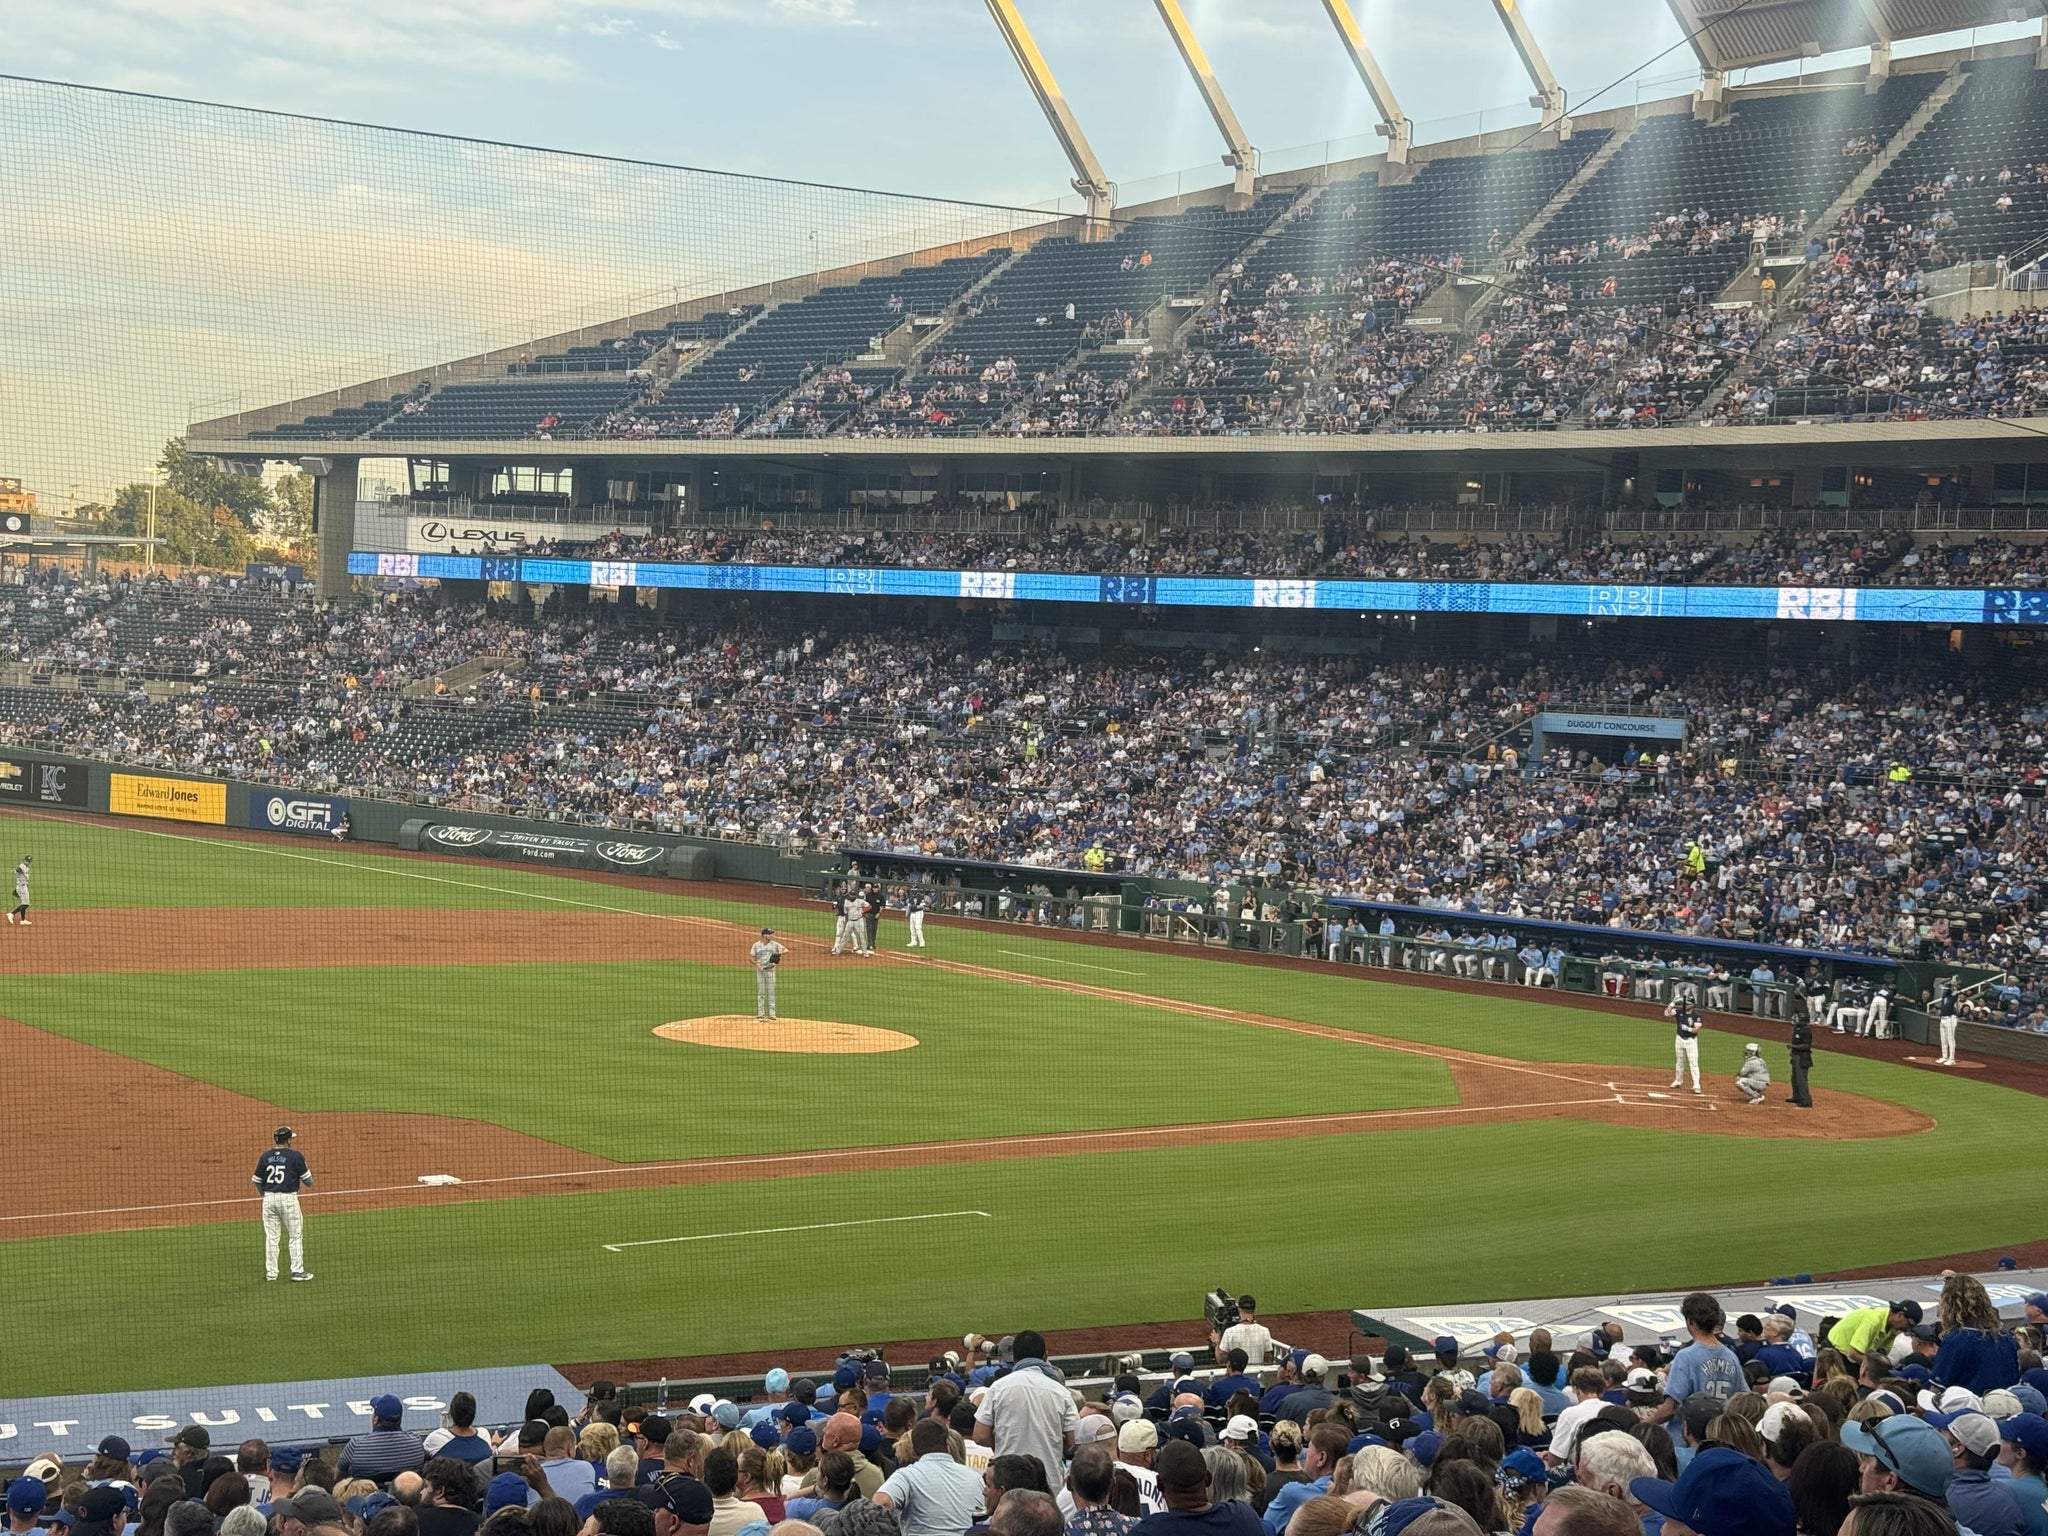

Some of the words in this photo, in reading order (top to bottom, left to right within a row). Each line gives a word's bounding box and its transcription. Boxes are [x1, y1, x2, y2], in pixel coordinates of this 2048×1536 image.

[450, 529, 525, 543] LEXUS
[269, 565, 287, 578] DROP
[377, 554, 418, 577] RBI
[481, 556, 521, 581] RBI
[590, 561, 636, 586] RBI
[960, 571, 1015, 598] RBI
[1100, 574, 1156, 603] RBI
[1254, 579, 1316, 608] RBI
[1777, 587, 1857, 620] RBI
[1983, 590, 2048, 624] RB
[1567, 719, 1602, 729] DUGOUT
[1603, 722, 1656, 732] CONCOURSE
[41, 765, 66, 801] KC
[137, 783, 170, 799] Edward
[170, 787, 199, 802] Jones
[286, 818, 330, 831] DIGITAL
[438, 826, 478, 843] Ford
[511, 834, 540, 843] DRIVEN
[522, 848, 555, 859] Ford.com
[607, 842, 649, 860] Ford
[266, 1165, 286, 1184] 25
[1617, 1308, 1686, 1324] 197
[1700, 1357, 1736, 1378] HOSMER
[132, 1396, 447, 1430] SUITES
